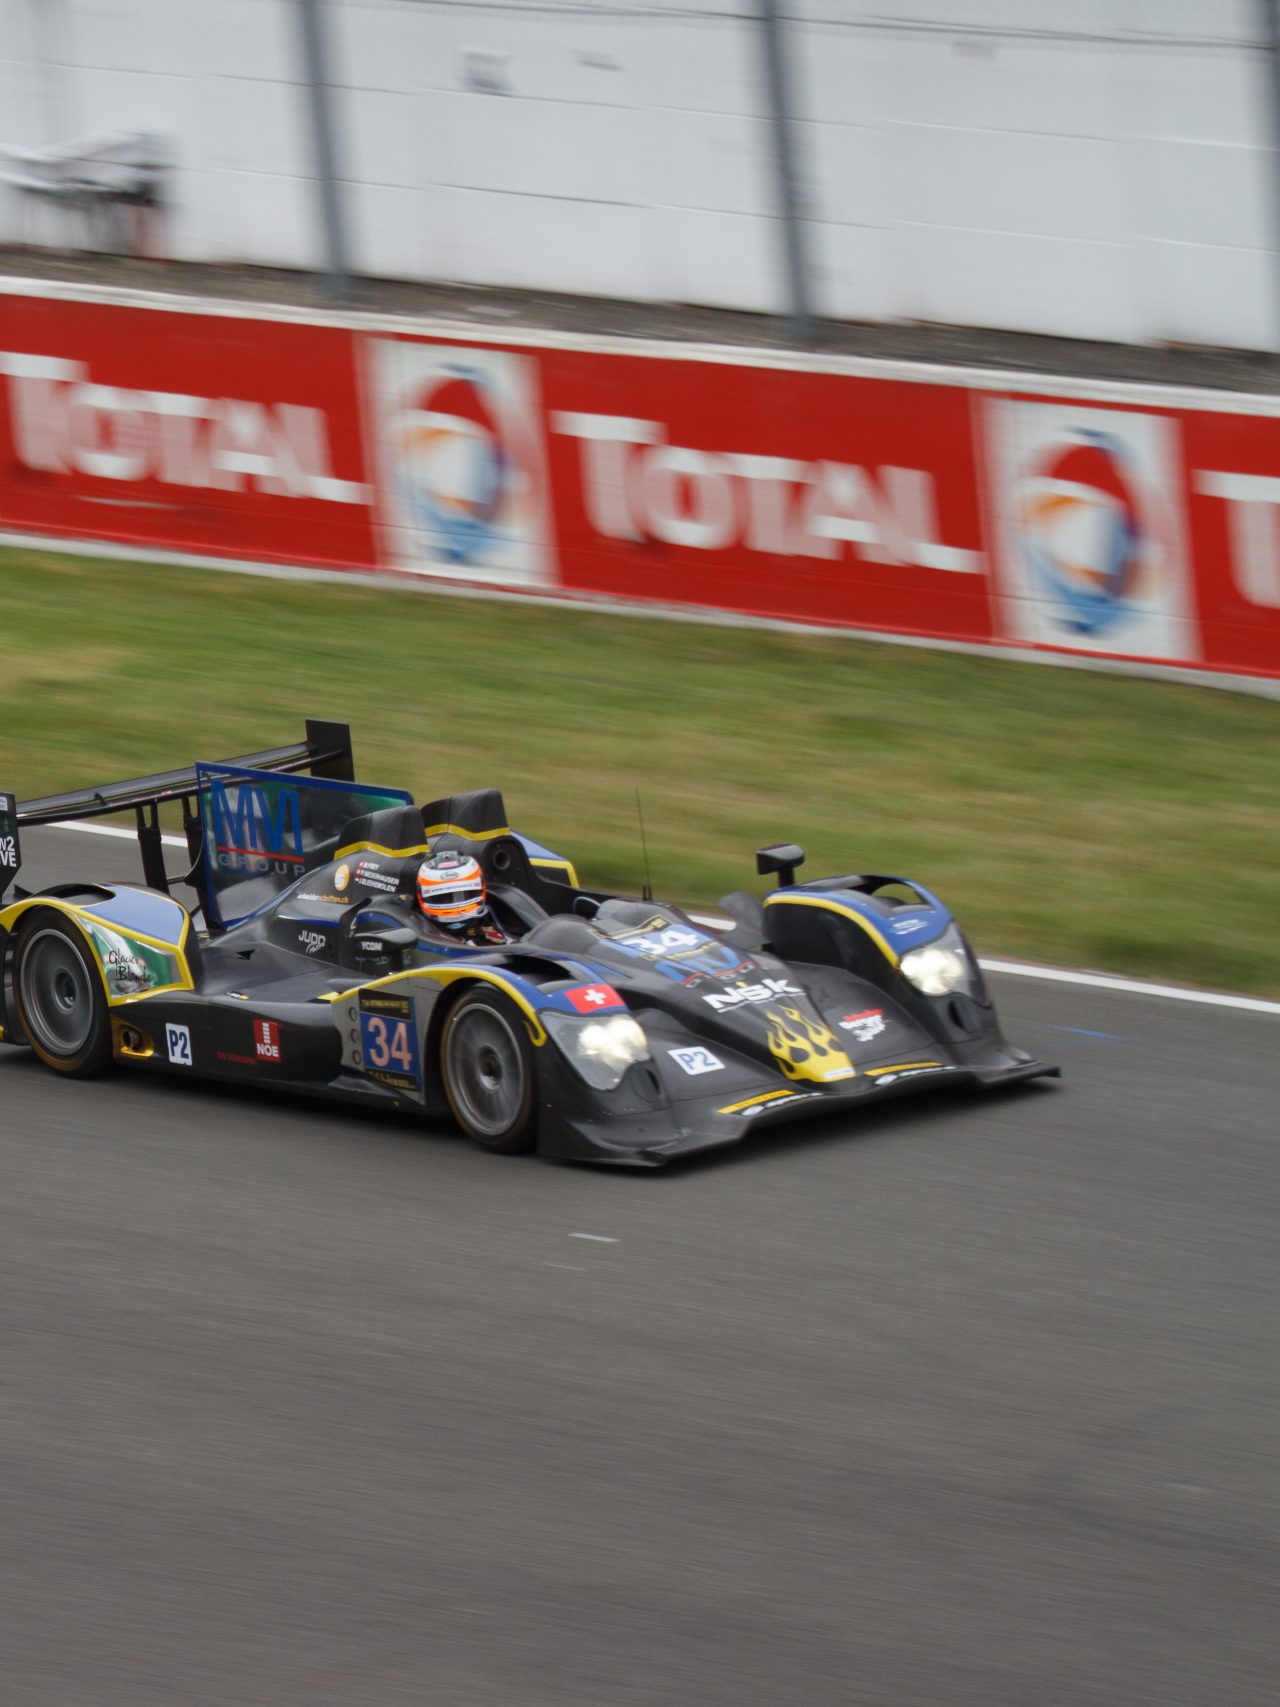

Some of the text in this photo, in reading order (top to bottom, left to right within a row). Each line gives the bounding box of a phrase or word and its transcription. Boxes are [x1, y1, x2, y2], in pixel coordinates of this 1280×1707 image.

[550, 409, 989, 576] TOTAL
[211, 780, 304, 855] MVI
[218, 852, 305, 877] GROUP
[298, 930, 326, 949] JUDD
[622, 929, 699, 955] 34
[169, 1030, 189, 1060] P2
[257, 1043, 279, 1057] NOE
[368, 1017, 413, 1071] 34
[677, 1050, 716, 1071] P2
